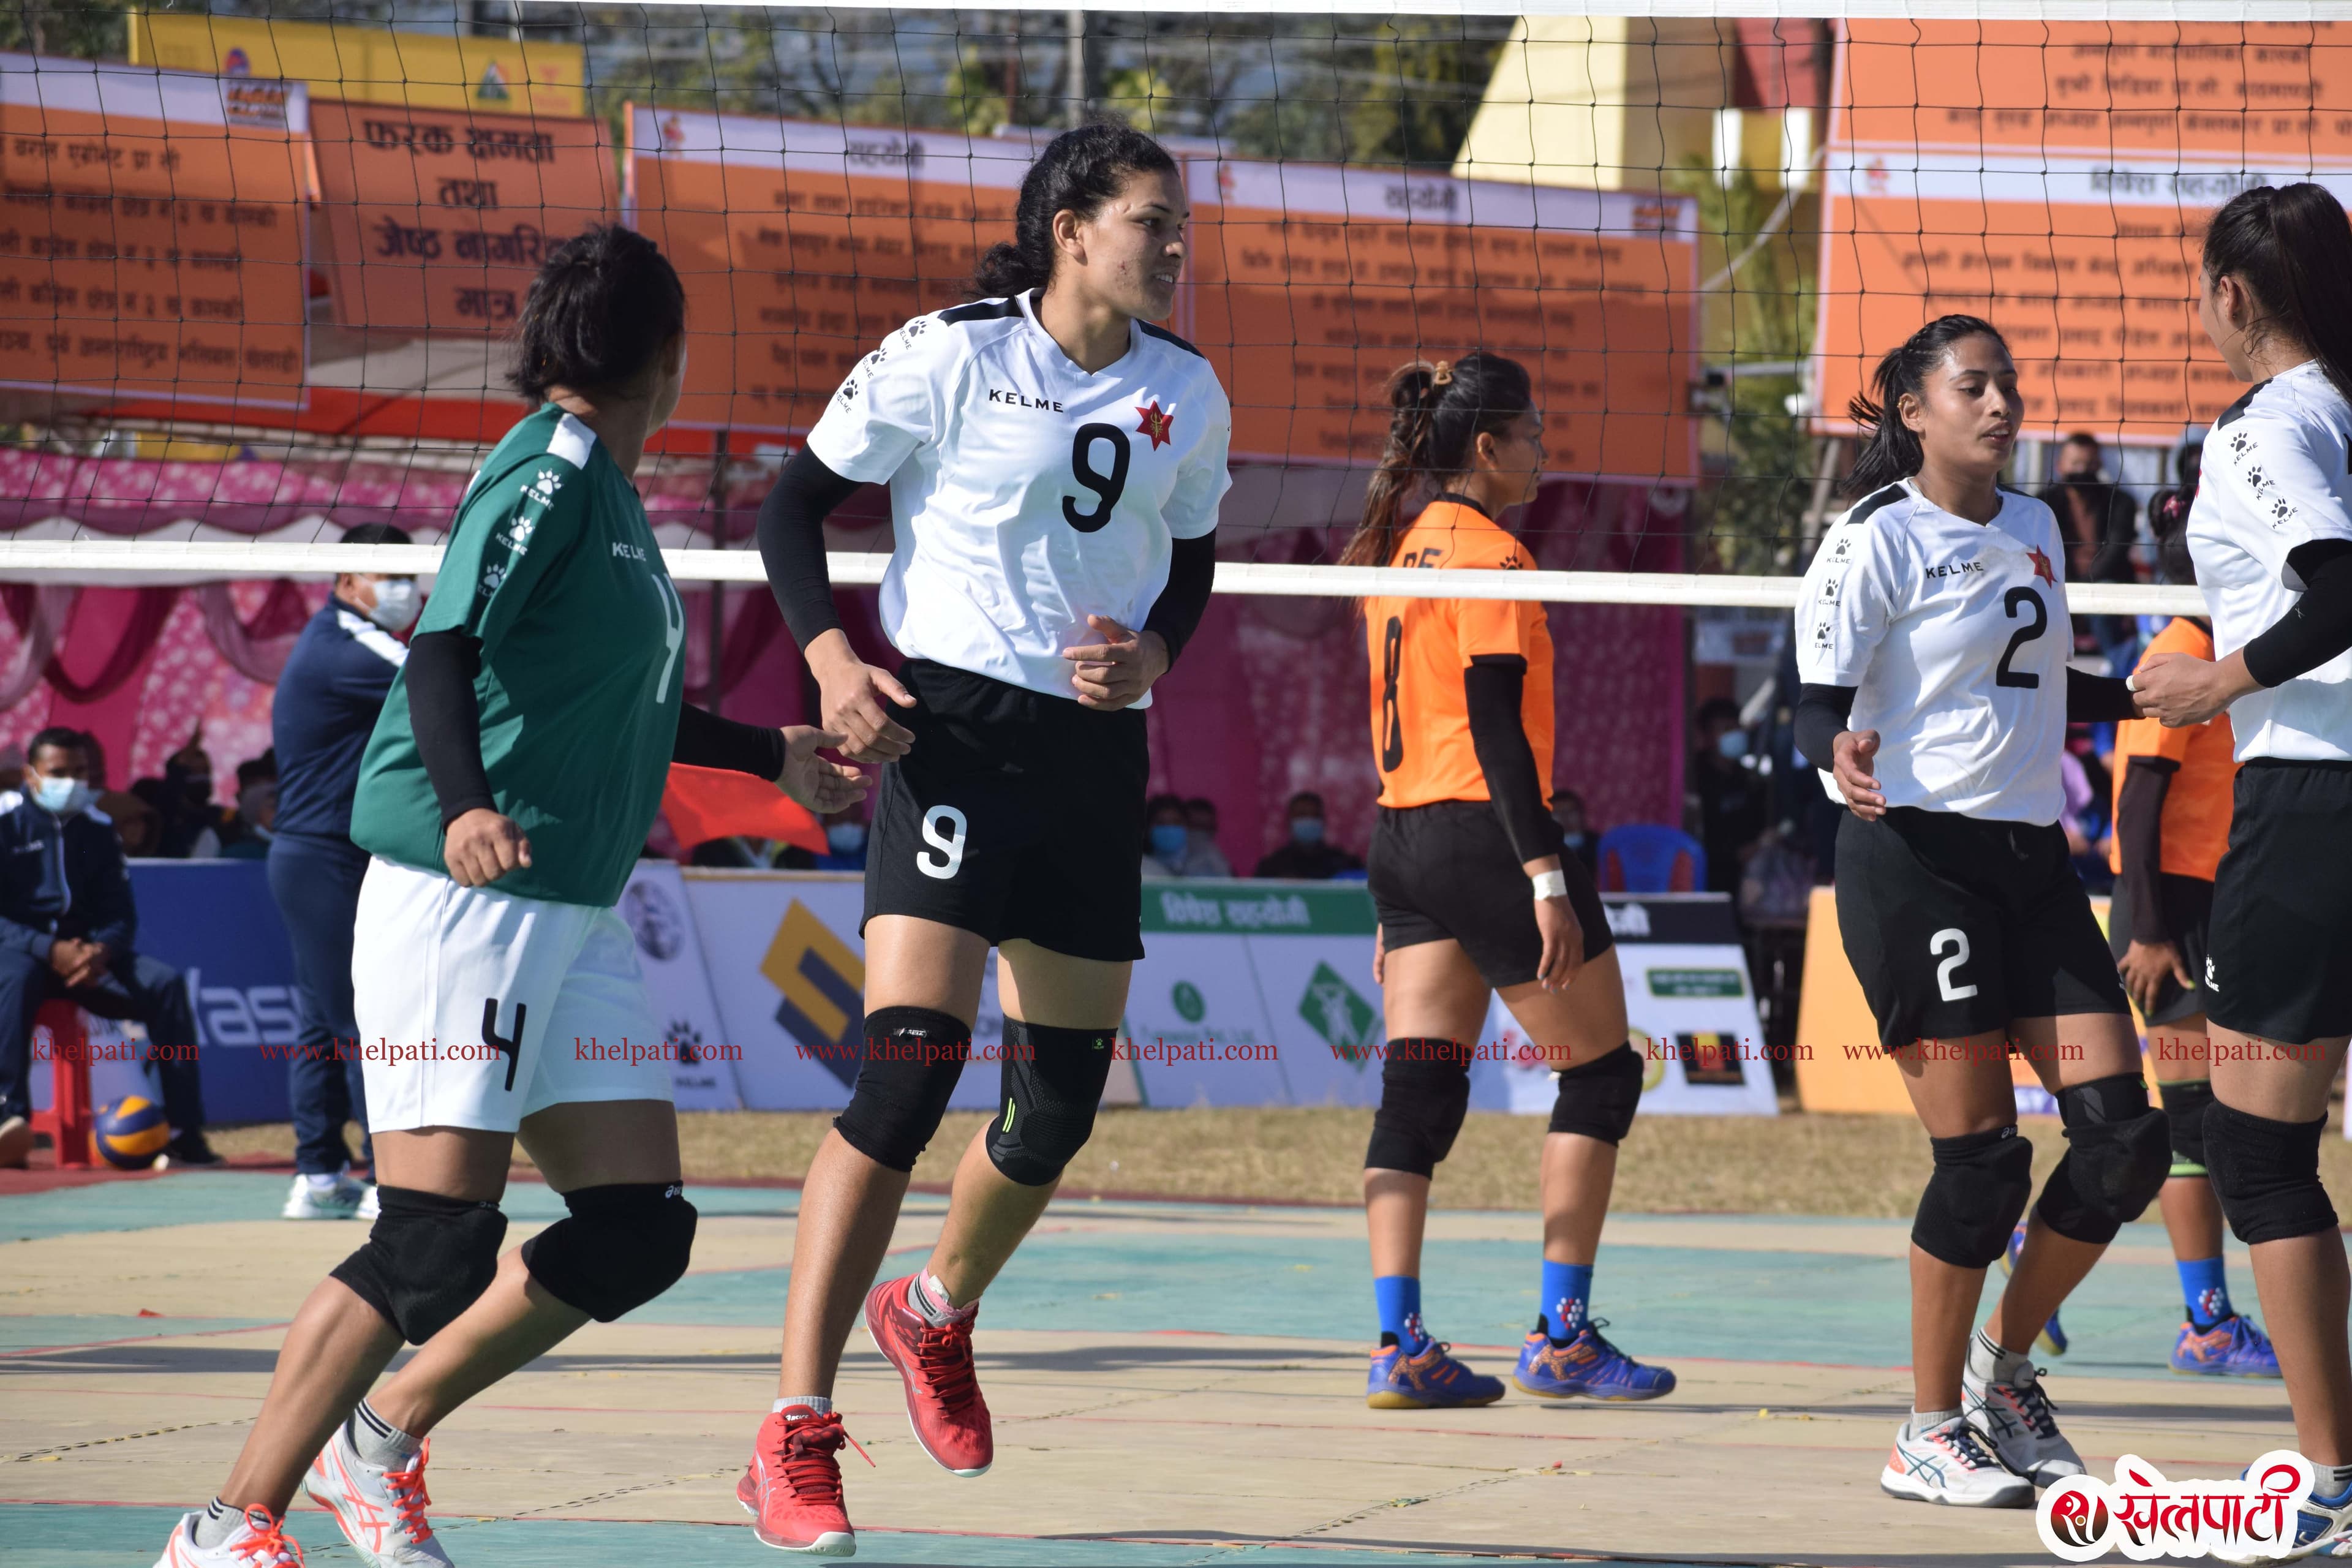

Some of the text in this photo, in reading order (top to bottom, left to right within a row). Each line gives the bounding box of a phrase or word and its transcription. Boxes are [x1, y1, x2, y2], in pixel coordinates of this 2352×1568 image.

[364, 120, 556, 164] फरक क्षमता
[438, 176, 500, 209] तथा
[989, 389, 1064, 413] KELME
[1062, 423, 1131, 533] 9
[495, 532, 528, 556] KELME
[2272, 507, 2299, 529] KELME
[1926, 561, 1985, 579] KELME
[1996, 586, 2048, 690] 2
[1382, 615, 1404, 774] 8
[916, 804, 968, 880] 9
[1929, 928, 1978, 1003] 2
[481, 997, 527, 1092] 4
